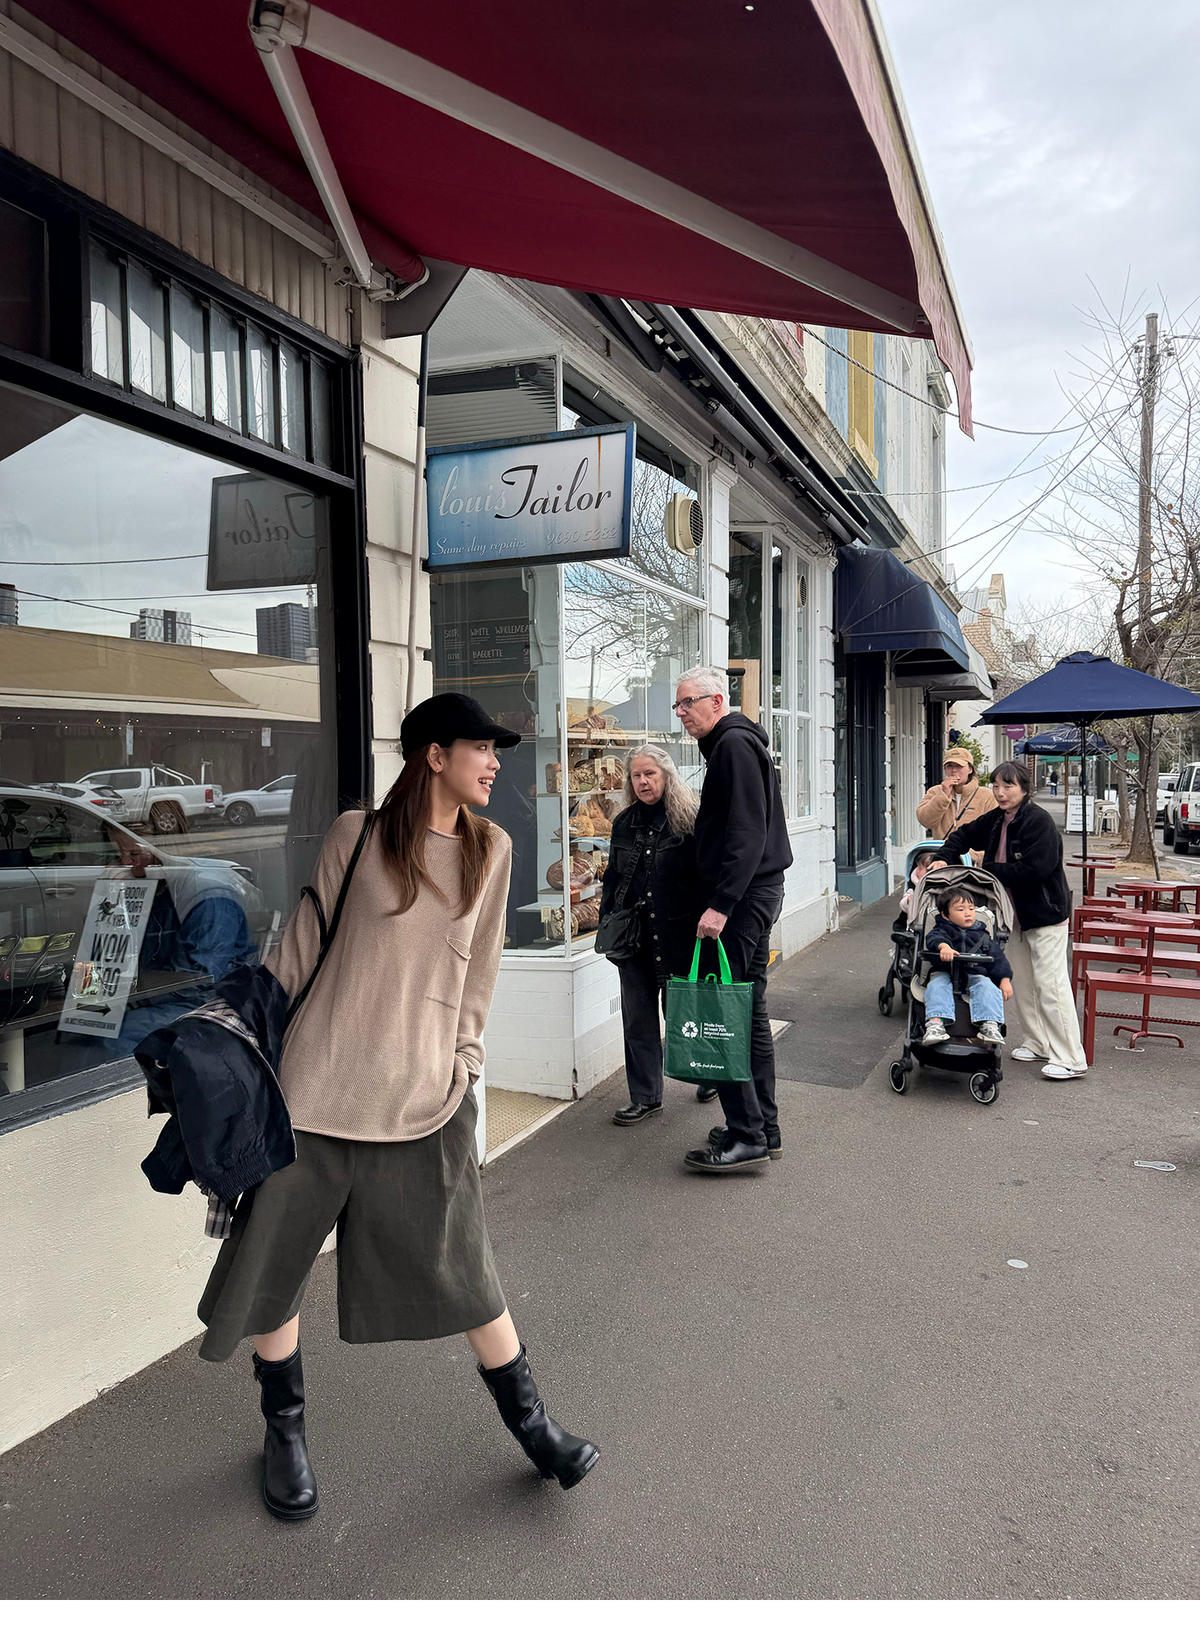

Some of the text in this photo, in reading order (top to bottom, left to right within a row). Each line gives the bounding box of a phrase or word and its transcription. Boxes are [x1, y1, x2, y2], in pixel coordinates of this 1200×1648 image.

[438, 457, 611, 519] louis Tailor
[547, 527, 618, 546] 9690 5382
[432, 536, 527, 556] Same day repairs
[470, 627, 490, 636] WHITE
[494, 624, 529, 634] WHOLEMEA
[472, 648, 503, 659] BAGUETTE
